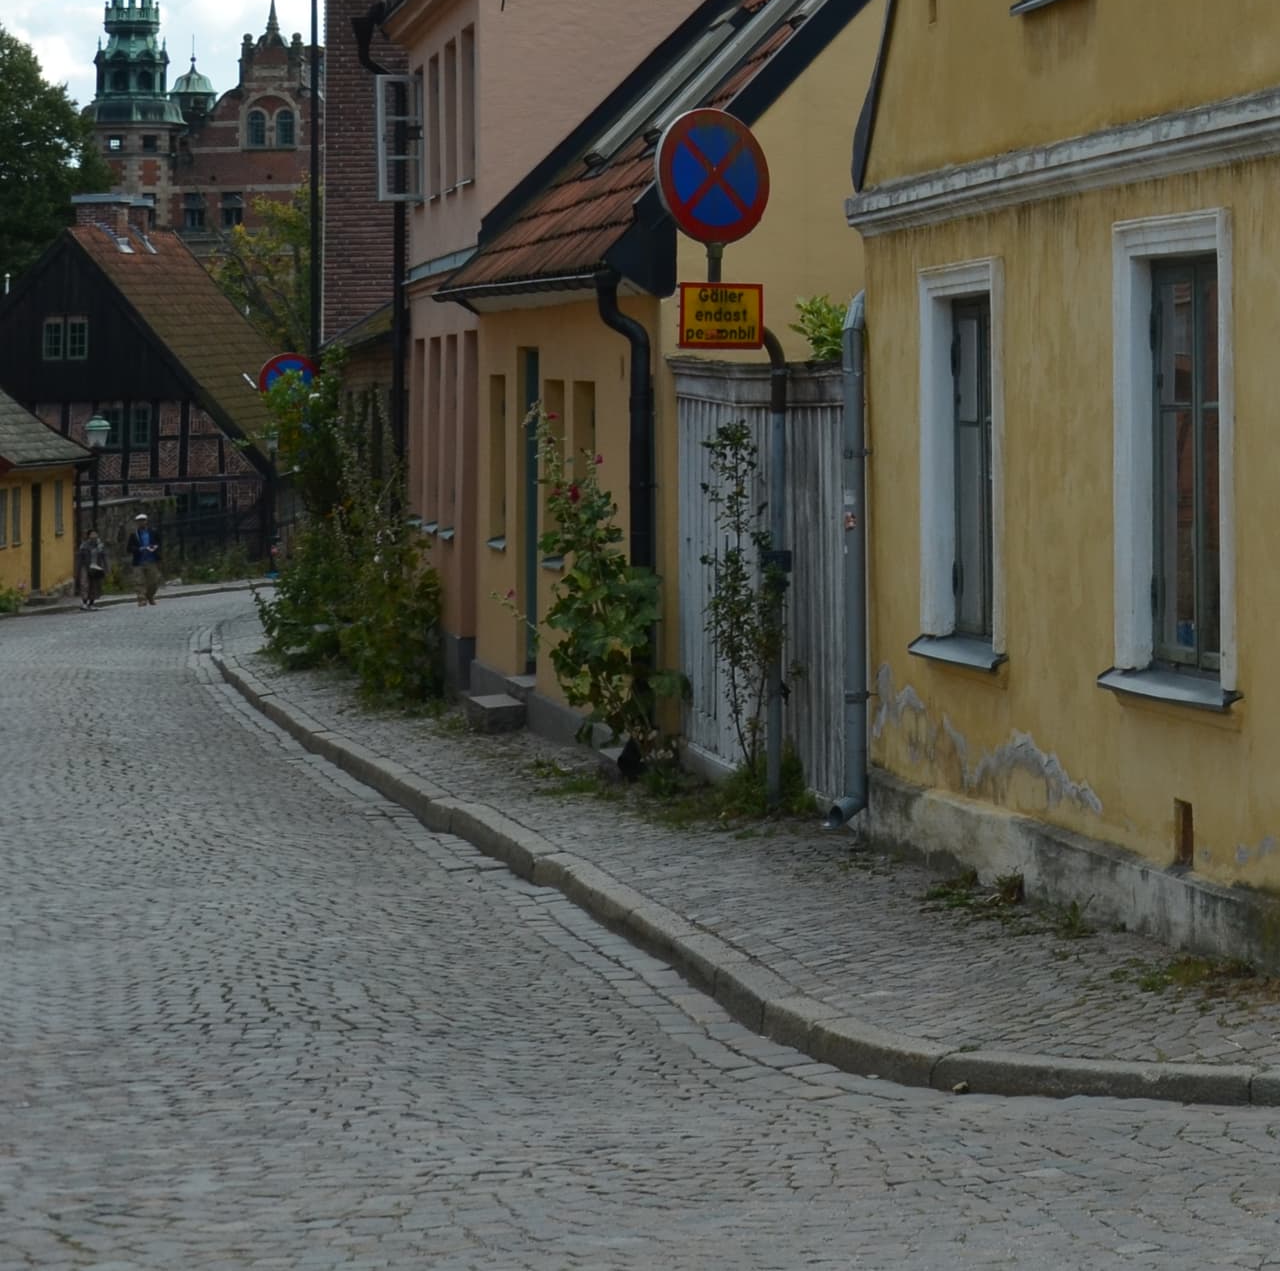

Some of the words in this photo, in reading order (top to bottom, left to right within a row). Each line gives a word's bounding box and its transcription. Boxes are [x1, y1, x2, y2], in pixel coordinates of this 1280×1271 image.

[698, 287, 744, 303] Gäller
[695, 307, 747, 322] endast
[686, 325, 755, 342] peonbil
